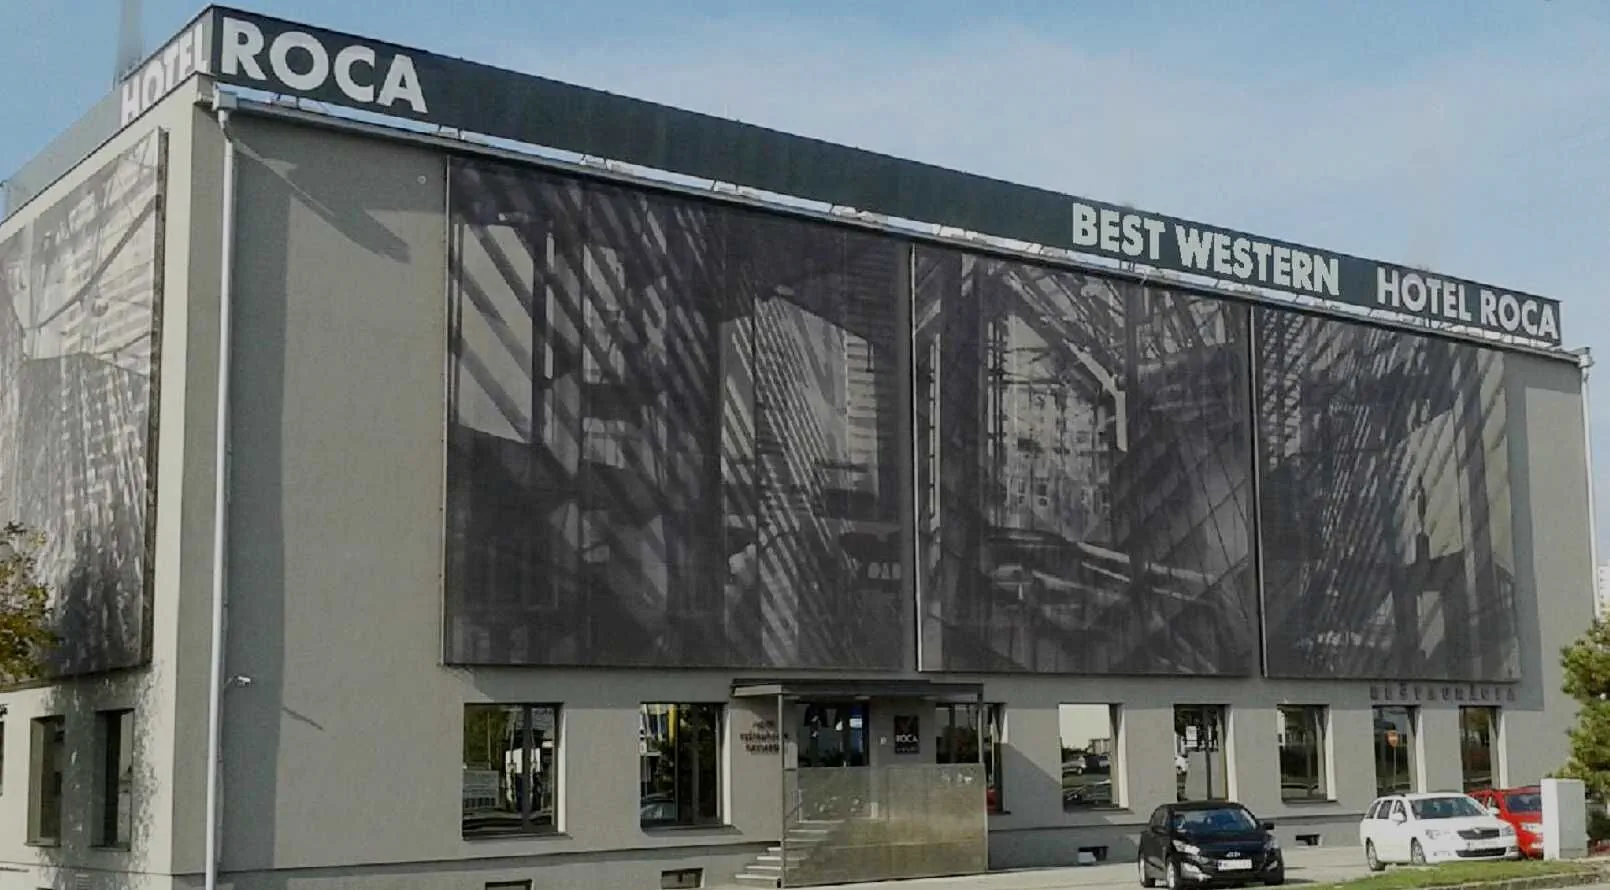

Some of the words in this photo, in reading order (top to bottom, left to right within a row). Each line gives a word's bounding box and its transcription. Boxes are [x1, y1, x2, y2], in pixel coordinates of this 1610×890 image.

[121, 23, 207, 127] HOTEL
[221, 16, 428, 114] ROCA
[1073, 203, 1165, 260] BEST
[1175, 223, 1339, 296] WESTERN
[1377, 267, 1472, 322] HOTEL
[1480, 289, 1559, 340] ROCA
